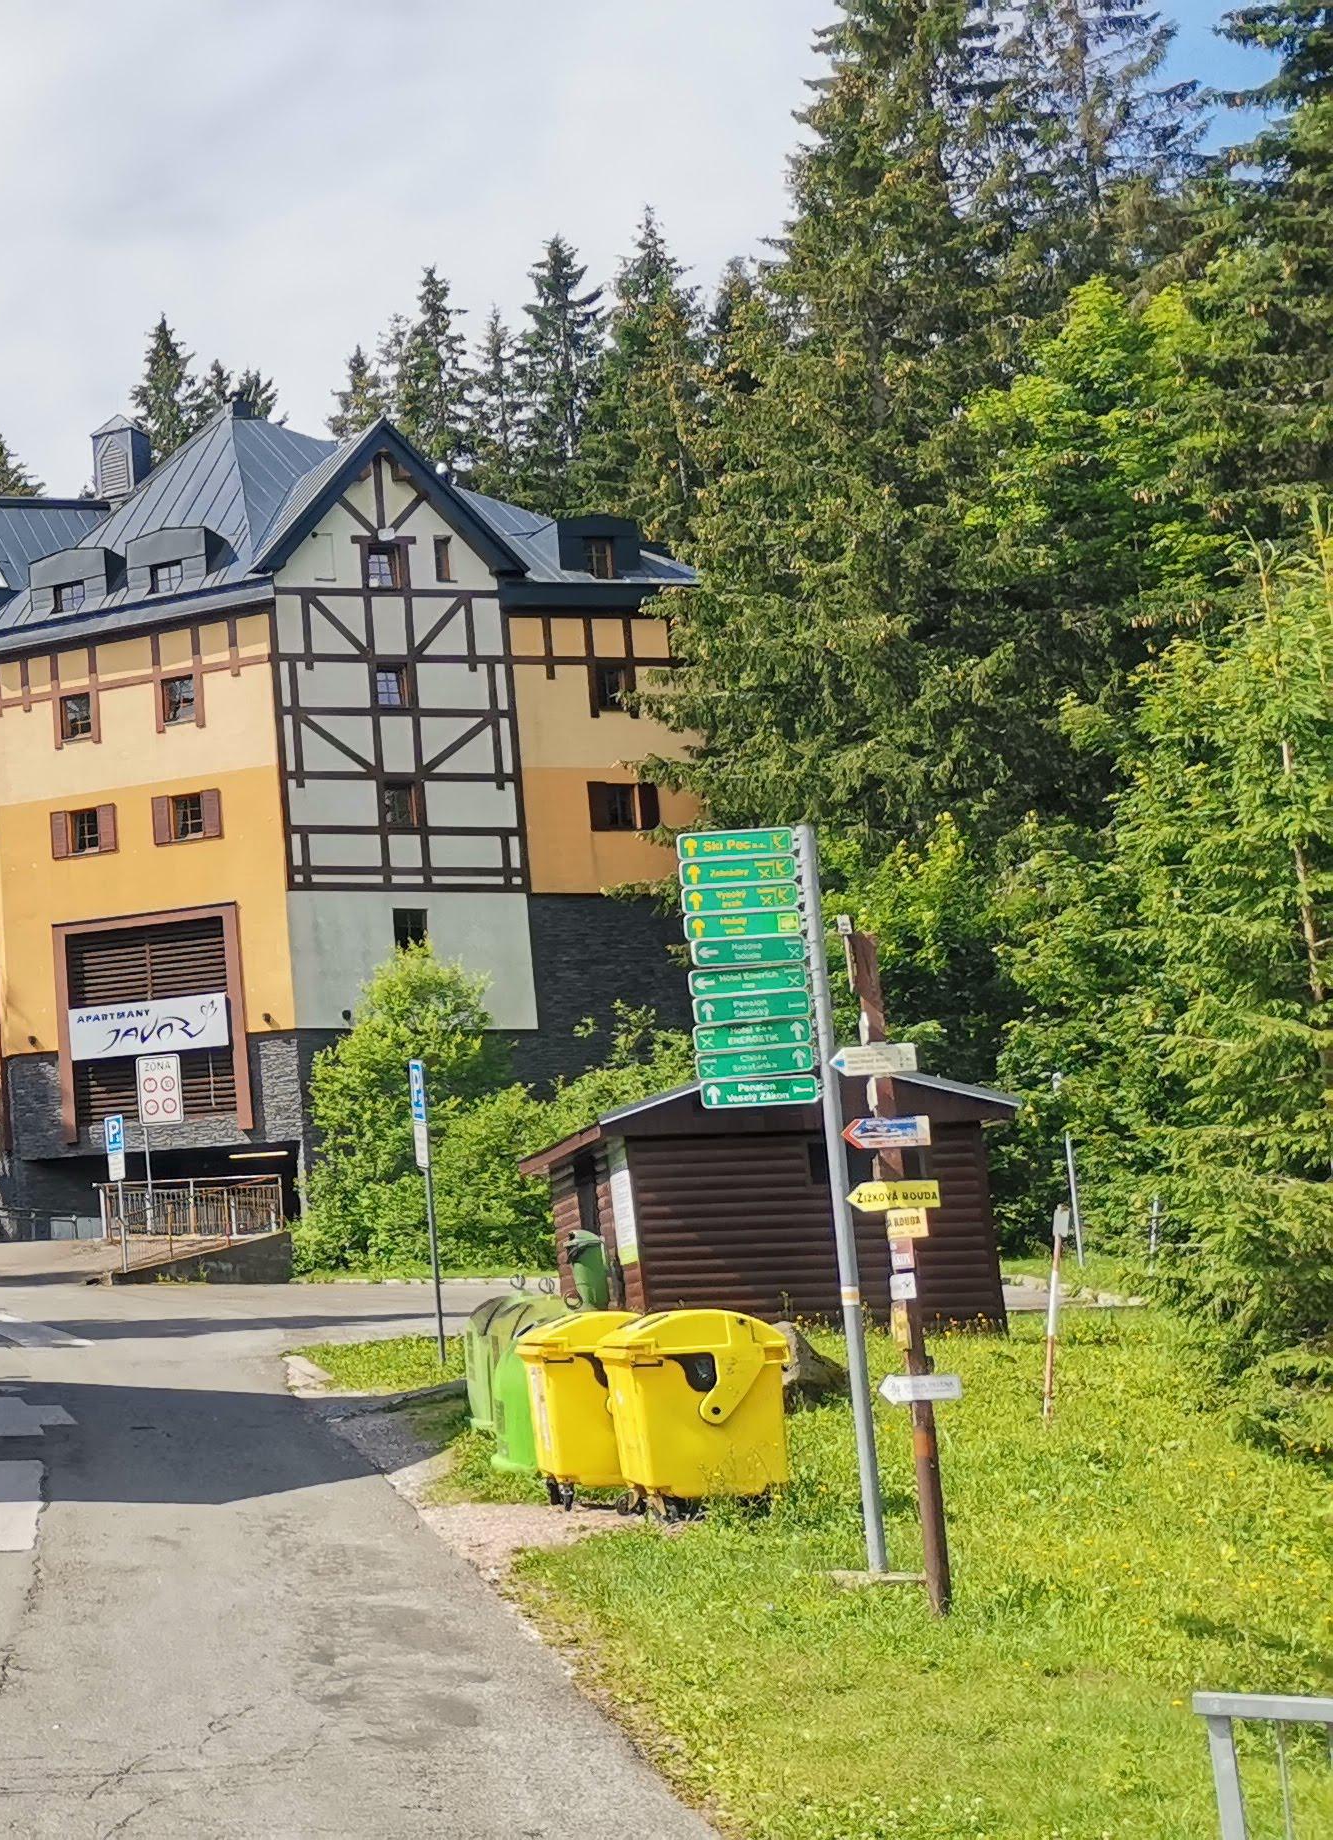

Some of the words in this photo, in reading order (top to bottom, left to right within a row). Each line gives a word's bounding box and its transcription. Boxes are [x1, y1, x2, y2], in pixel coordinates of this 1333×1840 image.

[703, 841, 723, 852] Ski
[76, 1009, 150, 1023] APARTMANY
[96, 1013, 207, 1053] JAVOR
[144, 1061, 171, 1072] ZONA
[902, 1190, 938, 1201] BOUDA
